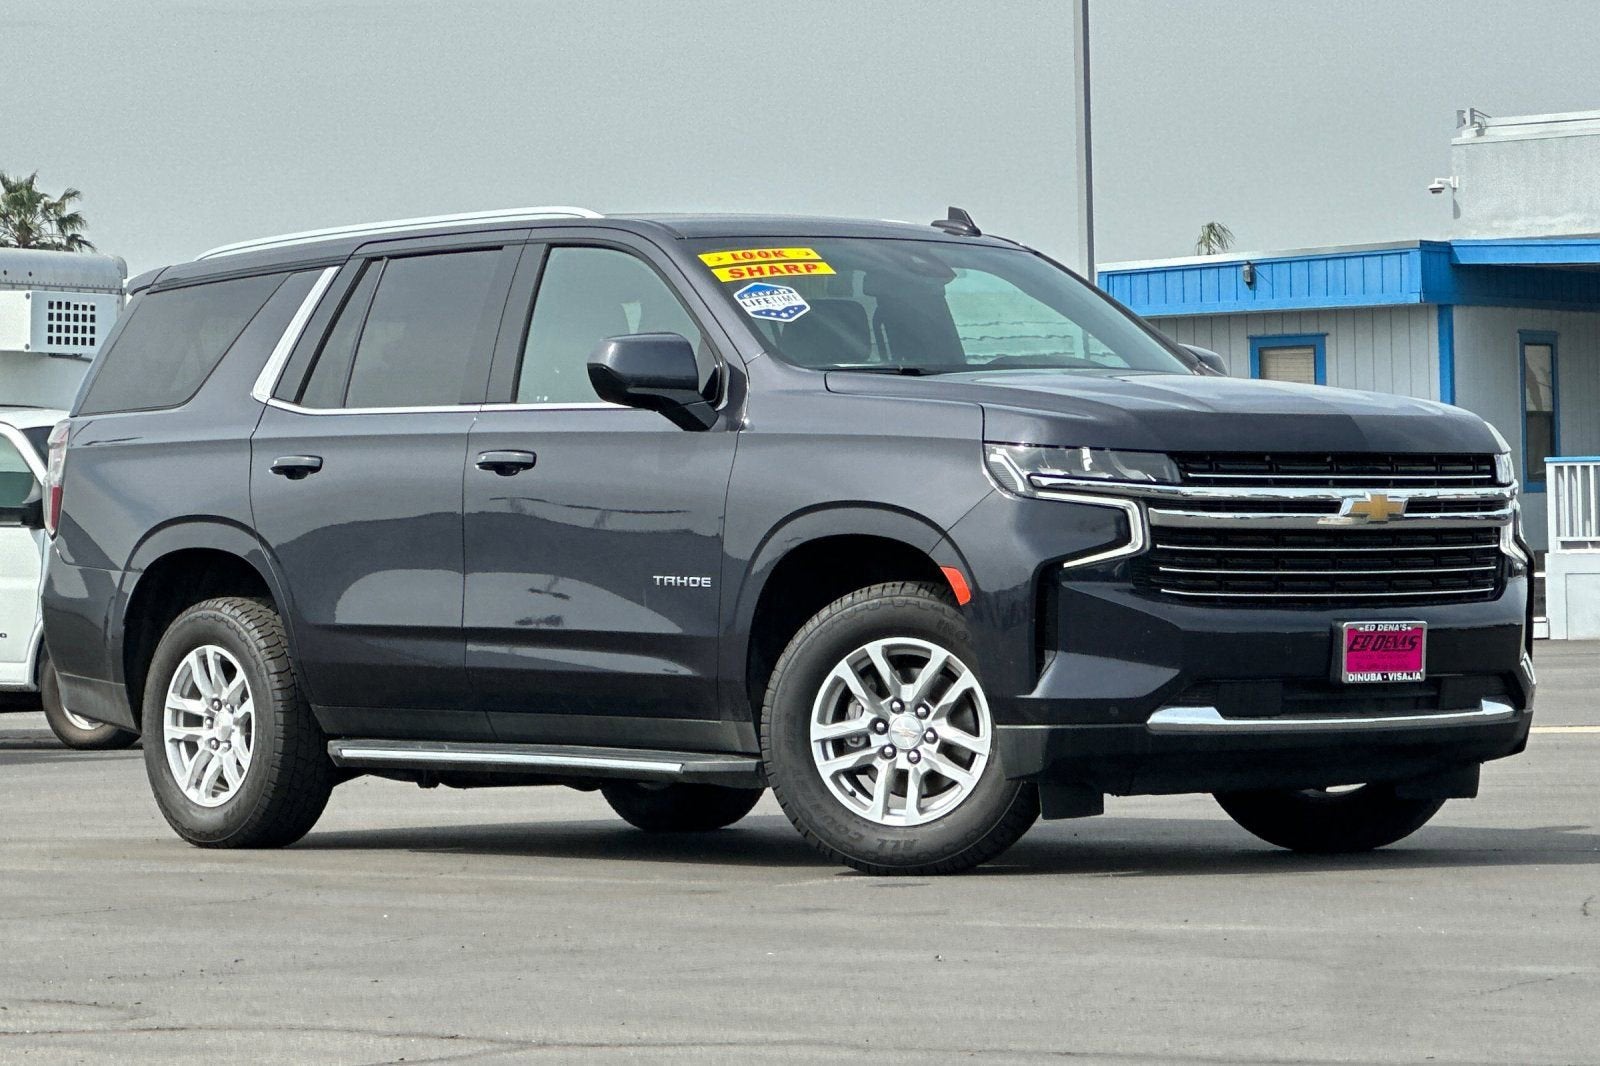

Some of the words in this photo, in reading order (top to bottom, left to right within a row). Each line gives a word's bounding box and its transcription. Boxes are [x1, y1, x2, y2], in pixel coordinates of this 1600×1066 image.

[731, 250, 788, 261] LOOK
[728, 263, 818, 279] SHARP
[742, 293, 801, 308] LIFETIME
[652, 575, 711, 588] TAHOE
[1364, 624, 1376, 632] ED
[1377, 623, 1408, 632] DENA'S
[1348, 673, 1382, 682] DINUBA
[1388, 671, 1421, 681] VISALIA
